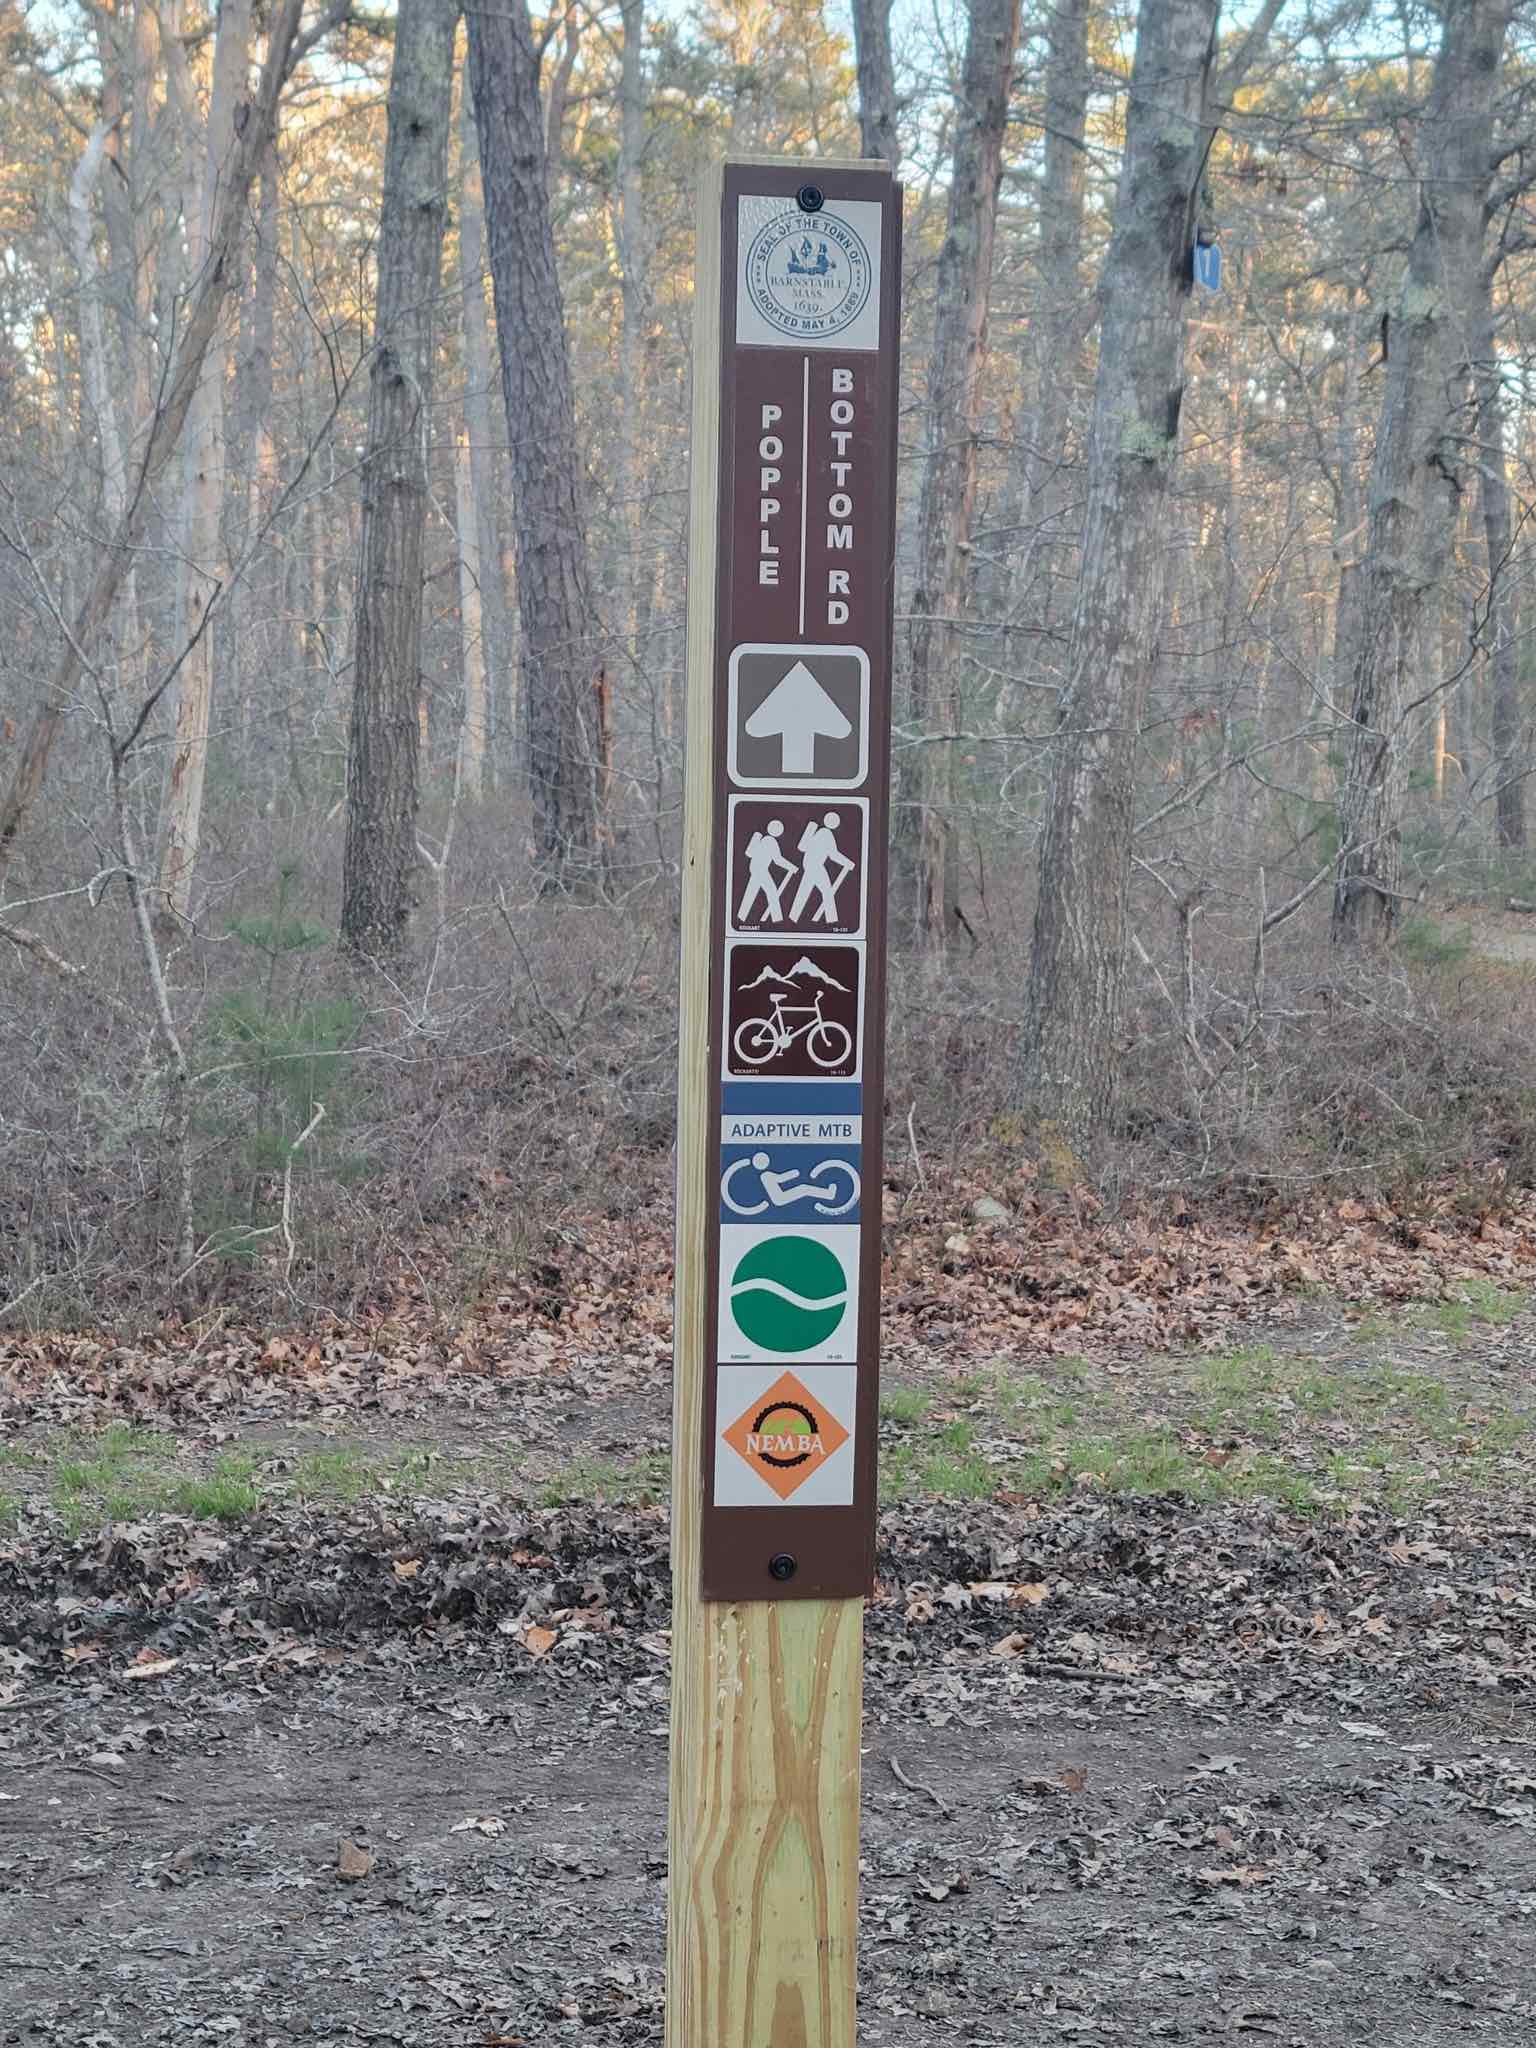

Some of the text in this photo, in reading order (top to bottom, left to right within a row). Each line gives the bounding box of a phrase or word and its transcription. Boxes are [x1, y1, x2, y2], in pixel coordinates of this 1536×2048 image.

[757, 233, 779, 262] SEAL
[796, 217, 819, 229] THE
[823, 222, 853, 250] TOWN
[849, 250, 862, 266] OF
[758, 288, 799, 328] ADOPTED
[802, 319, 826, 330] MAY
[759, 404, 784, 585] POPPLE
[827, 368, 855, 625] BOTTOM RD
[731, 1123, 852, 1137] ADAPTIVE MTB
[744, 1431, 829, 1456] NEMBA
